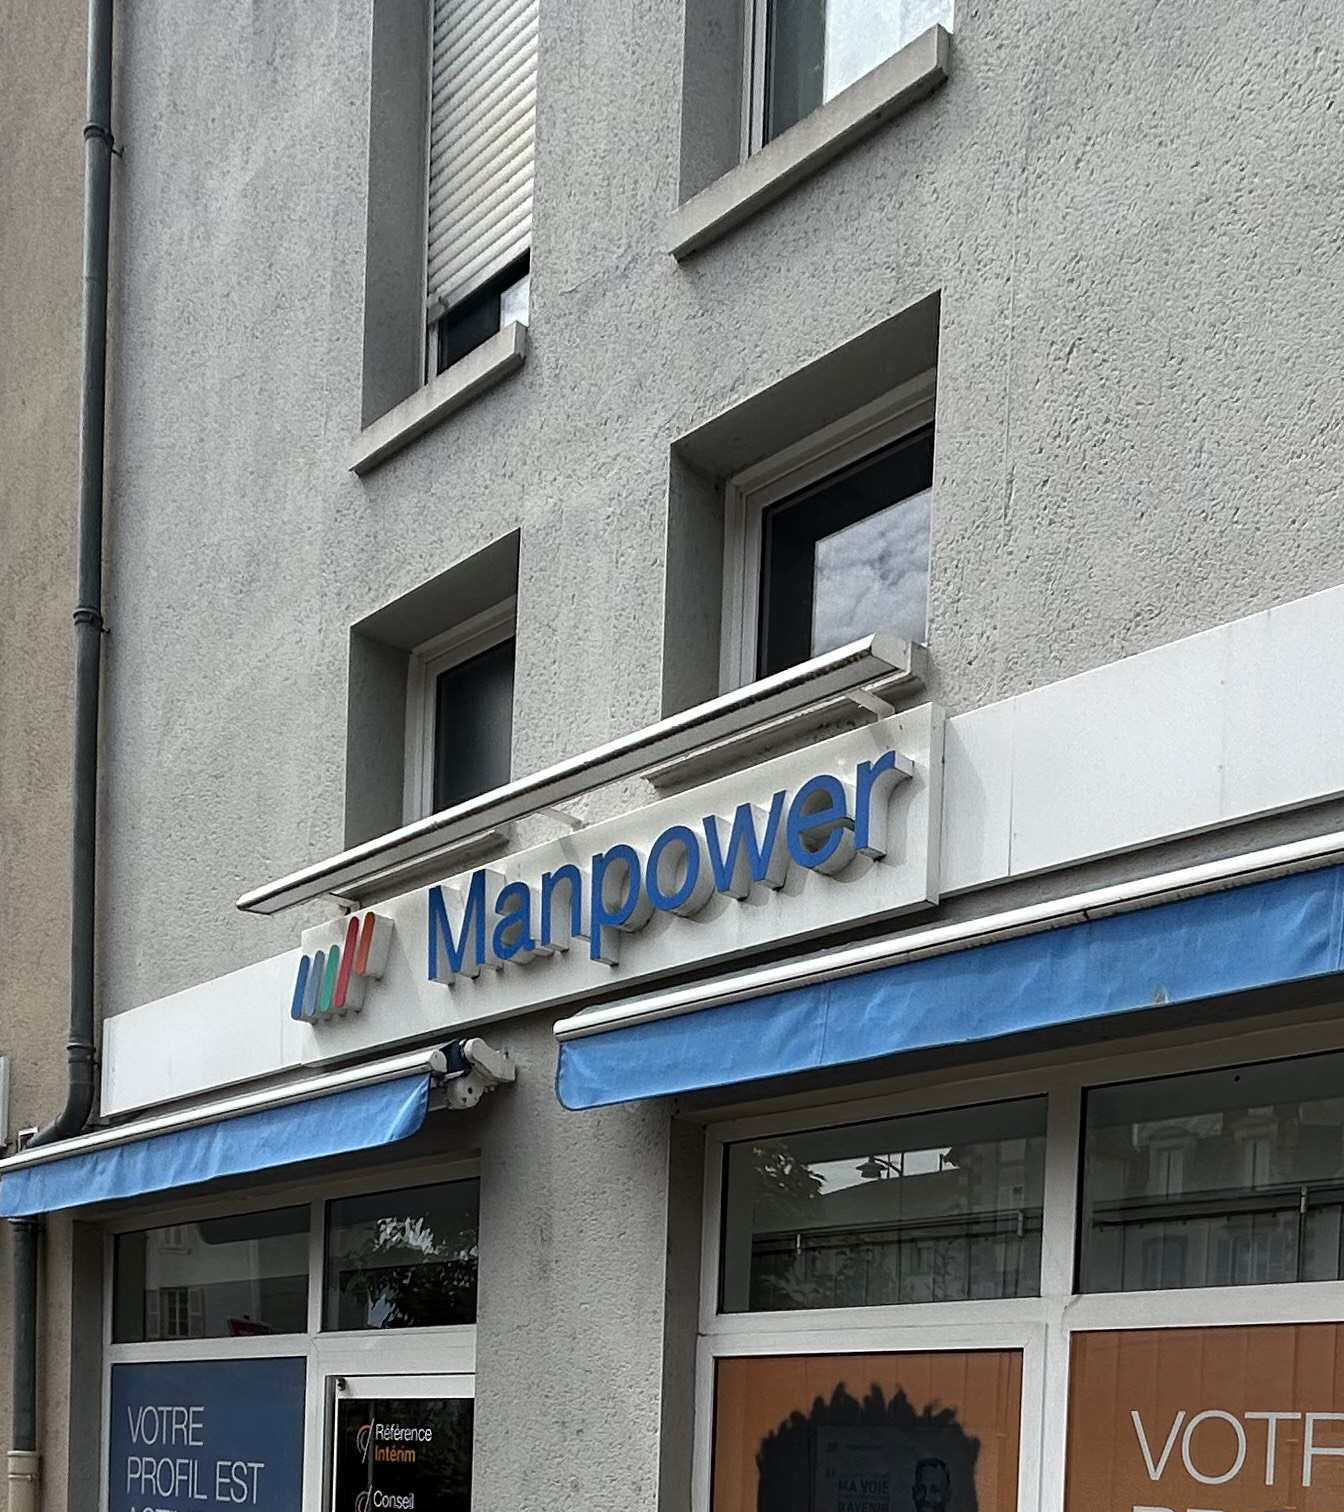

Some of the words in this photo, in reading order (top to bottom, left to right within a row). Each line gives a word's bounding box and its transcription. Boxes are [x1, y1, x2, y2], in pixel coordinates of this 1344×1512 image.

[428, 749, 906, 983] Manpower
[127, 1405, 205, 1446] VOTRE
[375, 1423, 432, 1442] Référence
[374, 1445, 416, 1463] Intérim
[126, 1456, 208, 1500] PROFIL
[215, 1460, 265, 1504] EST
[373, 1490, 414, 1509] Conseil
